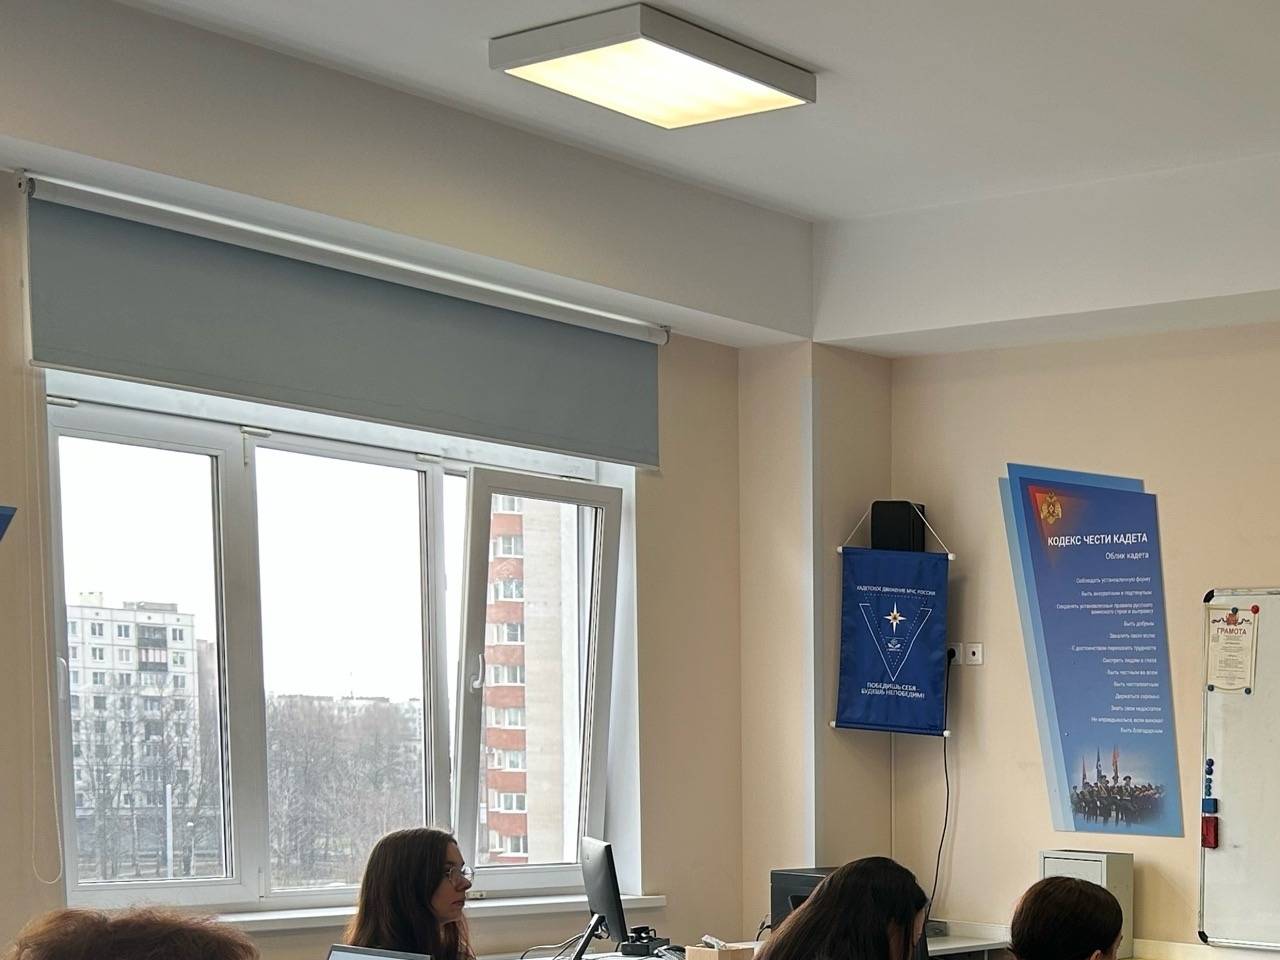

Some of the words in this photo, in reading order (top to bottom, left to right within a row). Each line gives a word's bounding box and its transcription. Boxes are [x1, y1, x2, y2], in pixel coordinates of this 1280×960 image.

[1048, 535, 1081, 547] КОДЕКС
[1083, 534, 1112, 545] ЧЕСТИ
[1113, 533, 1148, 544] КАДЕТА
[1105, 551, 1126, 560] Облик
[1126, 552, 1149, 560] кадета
[1216, 627, 1247, 635] ГРАМОТА
